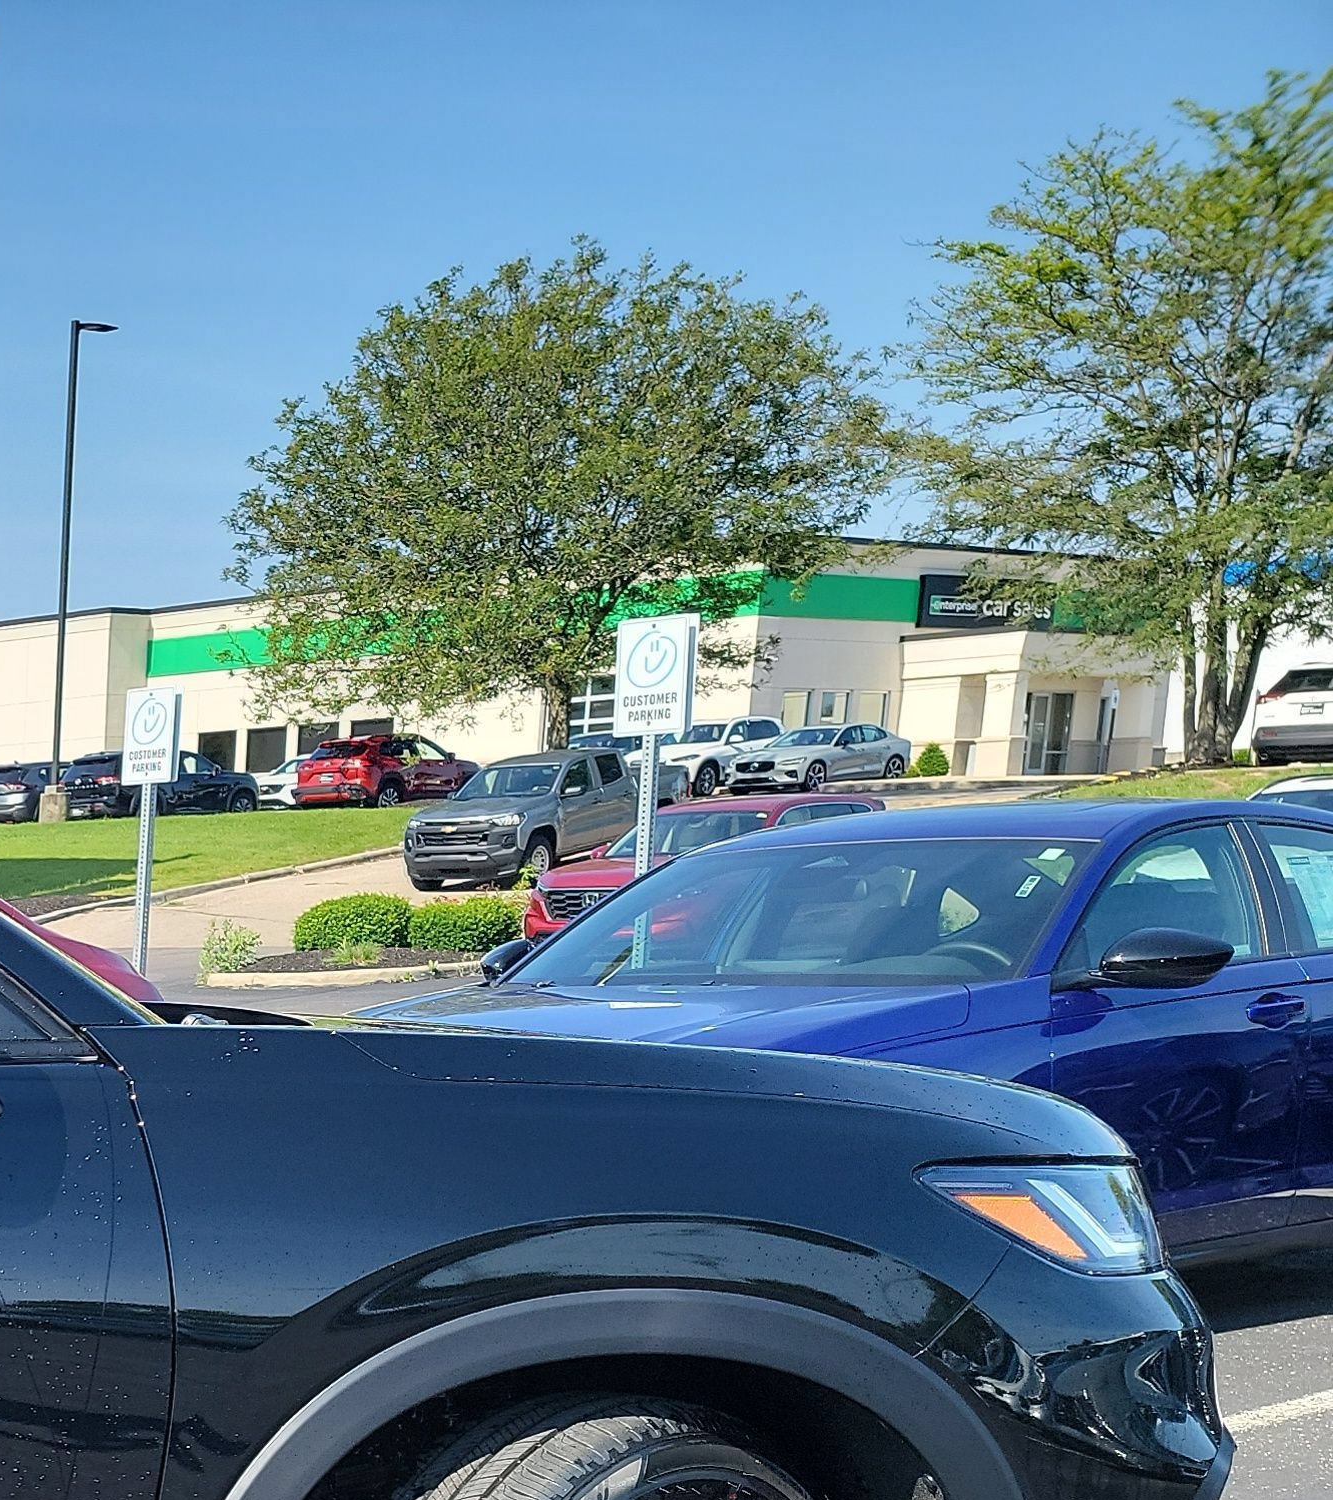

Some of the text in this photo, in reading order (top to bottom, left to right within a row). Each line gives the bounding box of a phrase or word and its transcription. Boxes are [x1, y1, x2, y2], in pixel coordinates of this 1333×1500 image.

[982, 599, 1011, 617] car
[623, 692, 678, 708] CUSTOMER
[628, 708, 671, 722] PARKING
[129, 748, 167, 761] CUSTOMER
[132, 761, 162, 774] PARKING
